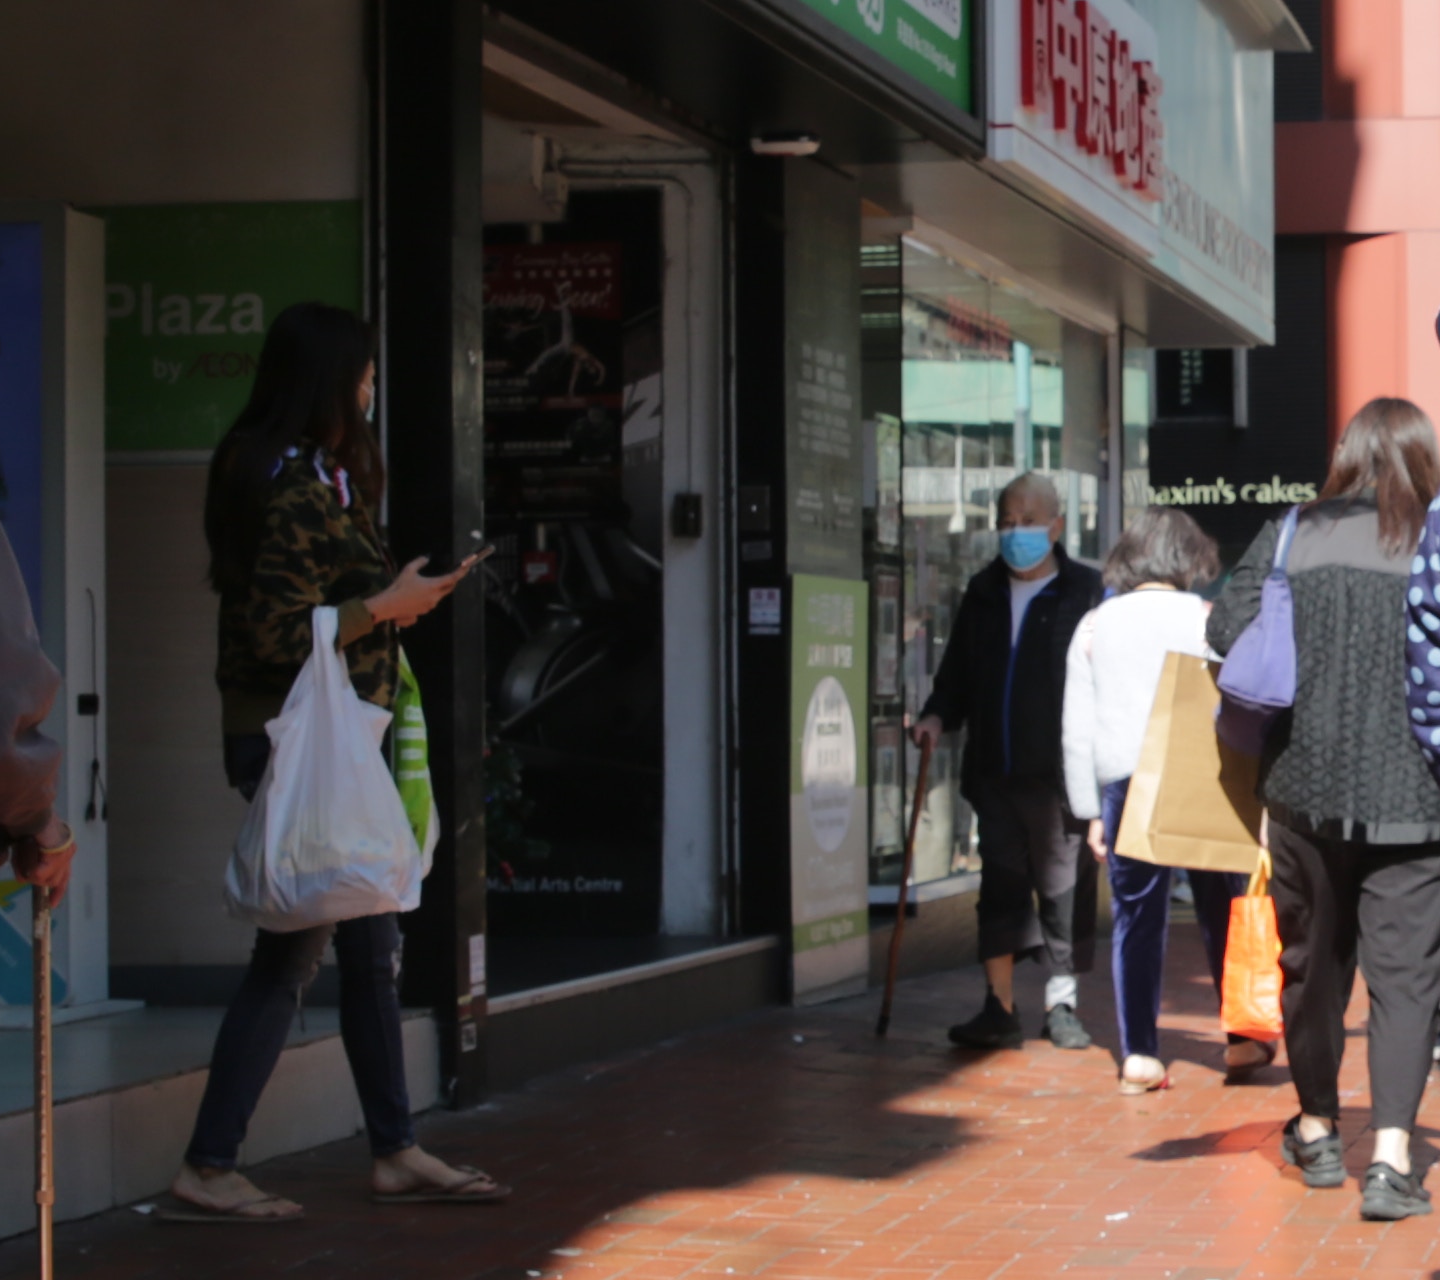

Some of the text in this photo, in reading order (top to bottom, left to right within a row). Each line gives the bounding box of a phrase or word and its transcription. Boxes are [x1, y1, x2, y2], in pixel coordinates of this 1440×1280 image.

[105, 282, 264, 338] Plaza
[152, 354, 183, 385] by
[1239, 474, 1318, 504] cakes
[539, 876, 571, 893] Arts
[573, 875, 624, 893] Centre
